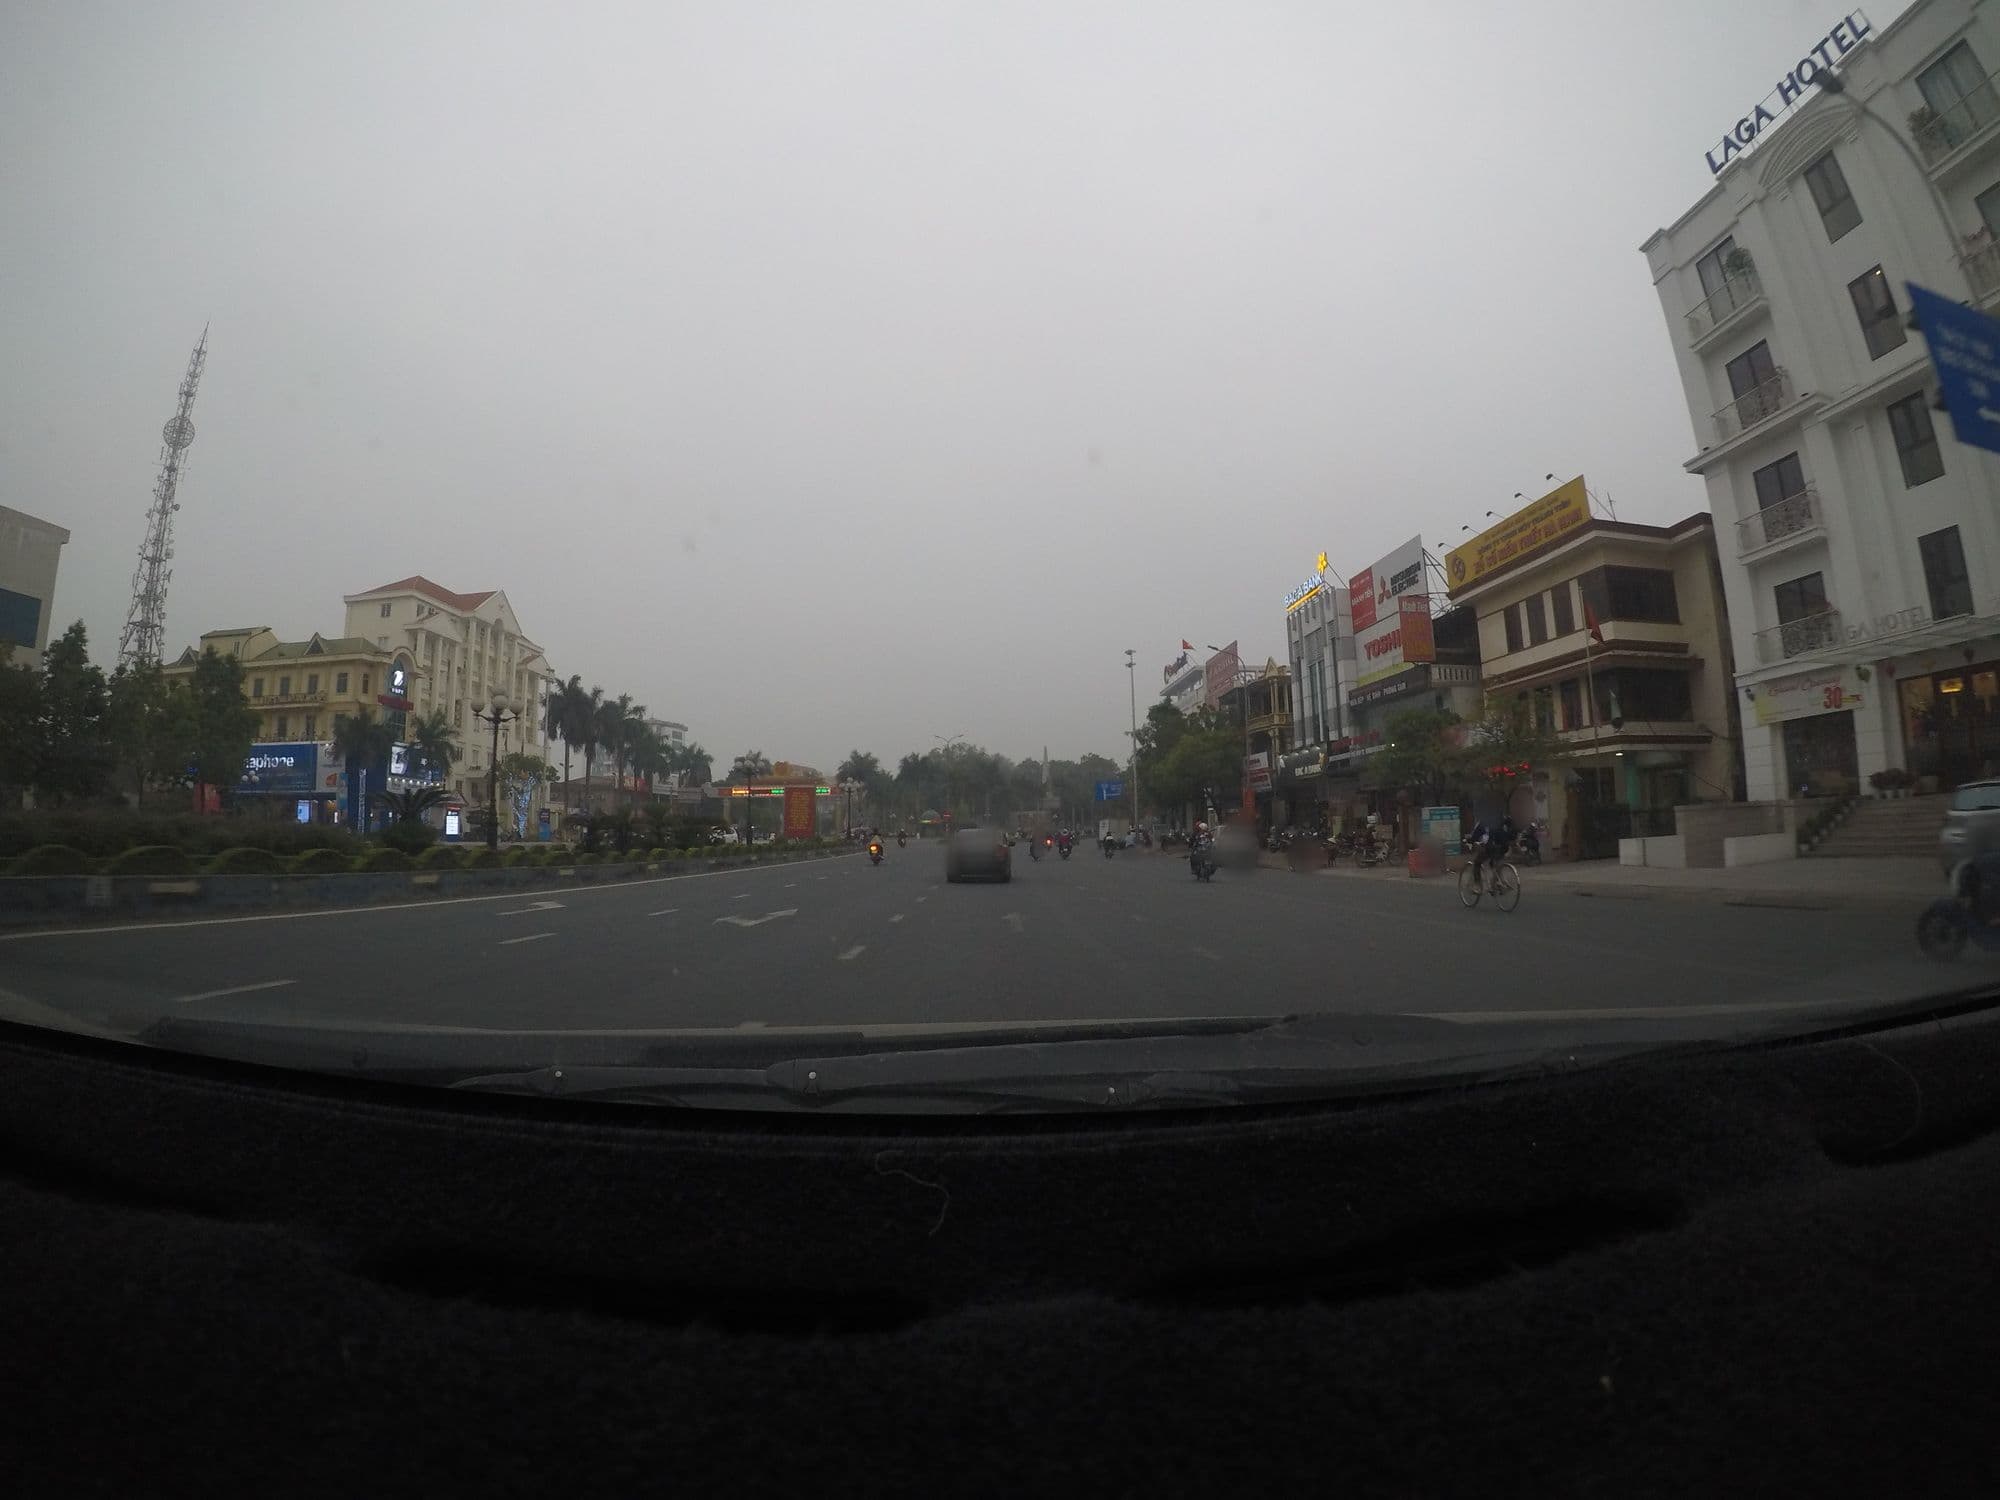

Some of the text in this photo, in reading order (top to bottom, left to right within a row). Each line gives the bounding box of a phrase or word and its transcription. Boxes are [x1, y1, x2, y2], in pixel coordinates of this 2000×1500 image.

[1705, 15, 1871, 174] LAGA HOTEL
[1823, 686, 1842, 709] 30
